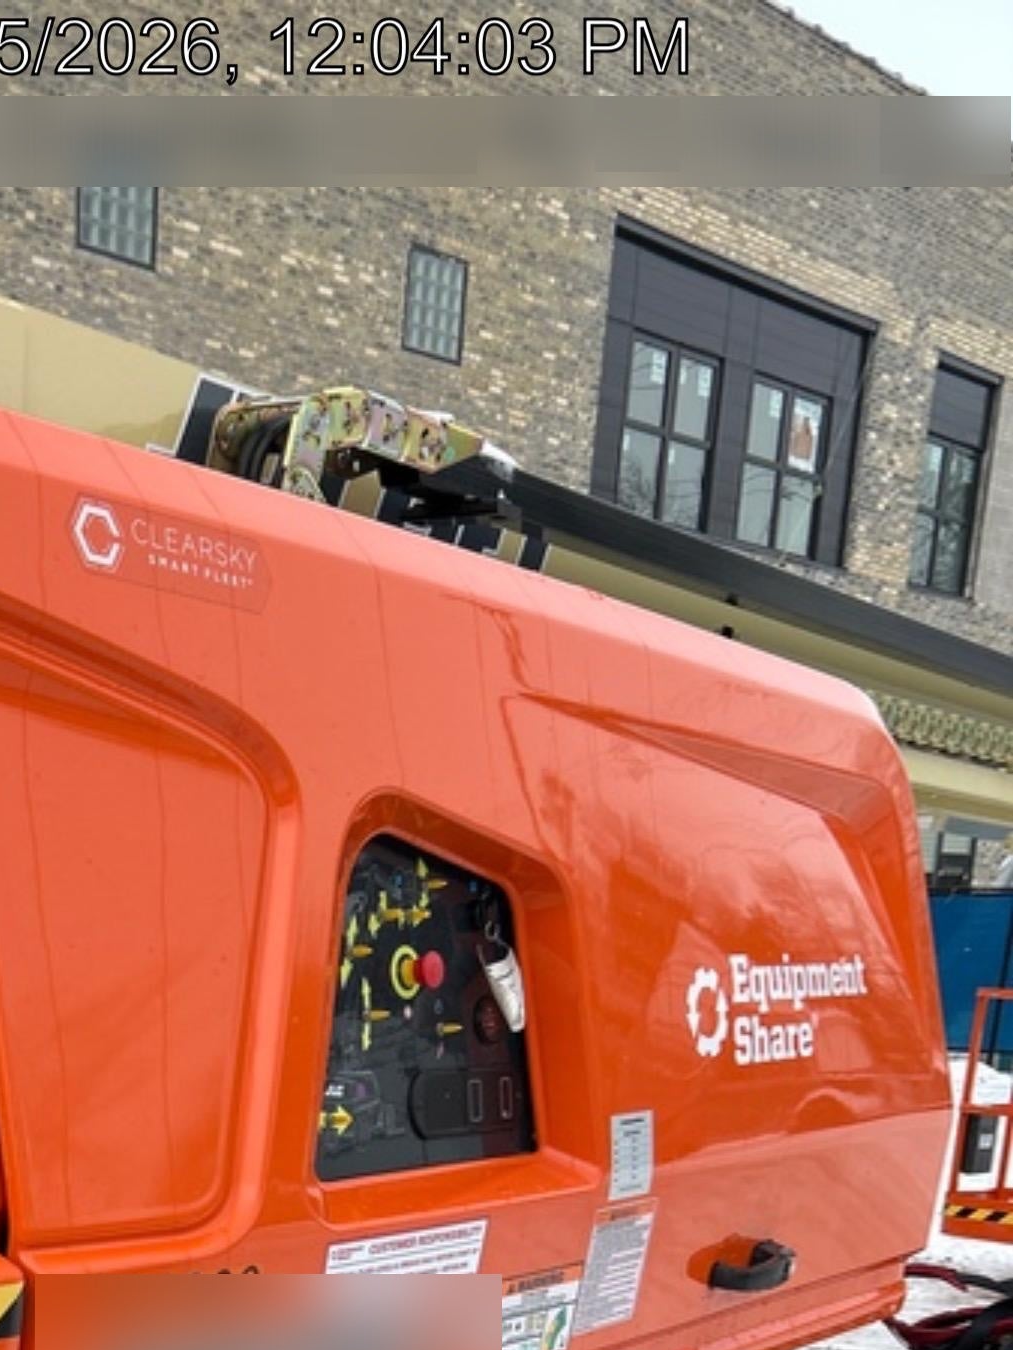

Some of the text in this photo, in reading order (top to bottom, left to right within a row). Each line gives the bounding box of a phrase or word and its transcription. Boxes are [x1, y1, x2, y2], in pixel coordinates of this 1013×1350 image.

[130, 518, 257, 573] CLEARSKY
[148, 553, 198, 577] SMART
[728, 953, 868, 1013] Equipment
[734, 1014, 814, 1066] Share
[368, 1236, 416, 1255] CUSTOMER
